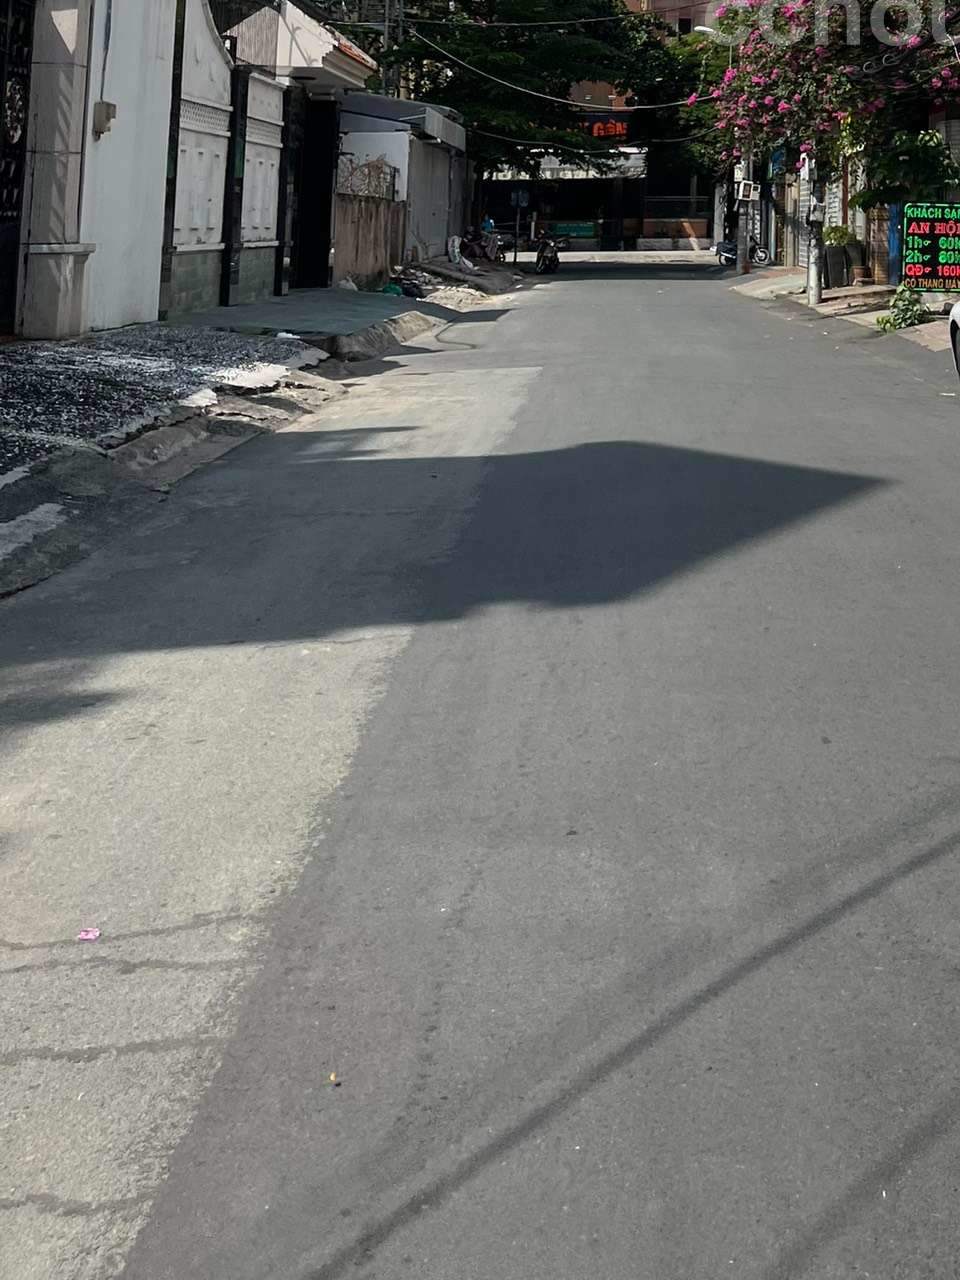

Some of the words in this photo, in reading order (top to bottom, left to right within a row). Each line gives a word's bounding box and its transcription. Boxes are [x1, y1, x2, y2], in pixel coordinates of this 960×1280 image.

[906, 204, 941, 218] KHÁCH
[908, 222, 930, 234] AN
[906, 236, 922, 248] 1h
[906, 250, 922, 262] 2h
[905, 276, 916, 288] CÓ
[918, 278, 943, 288] THANG
[945, 277, 960, 288] MÁY
